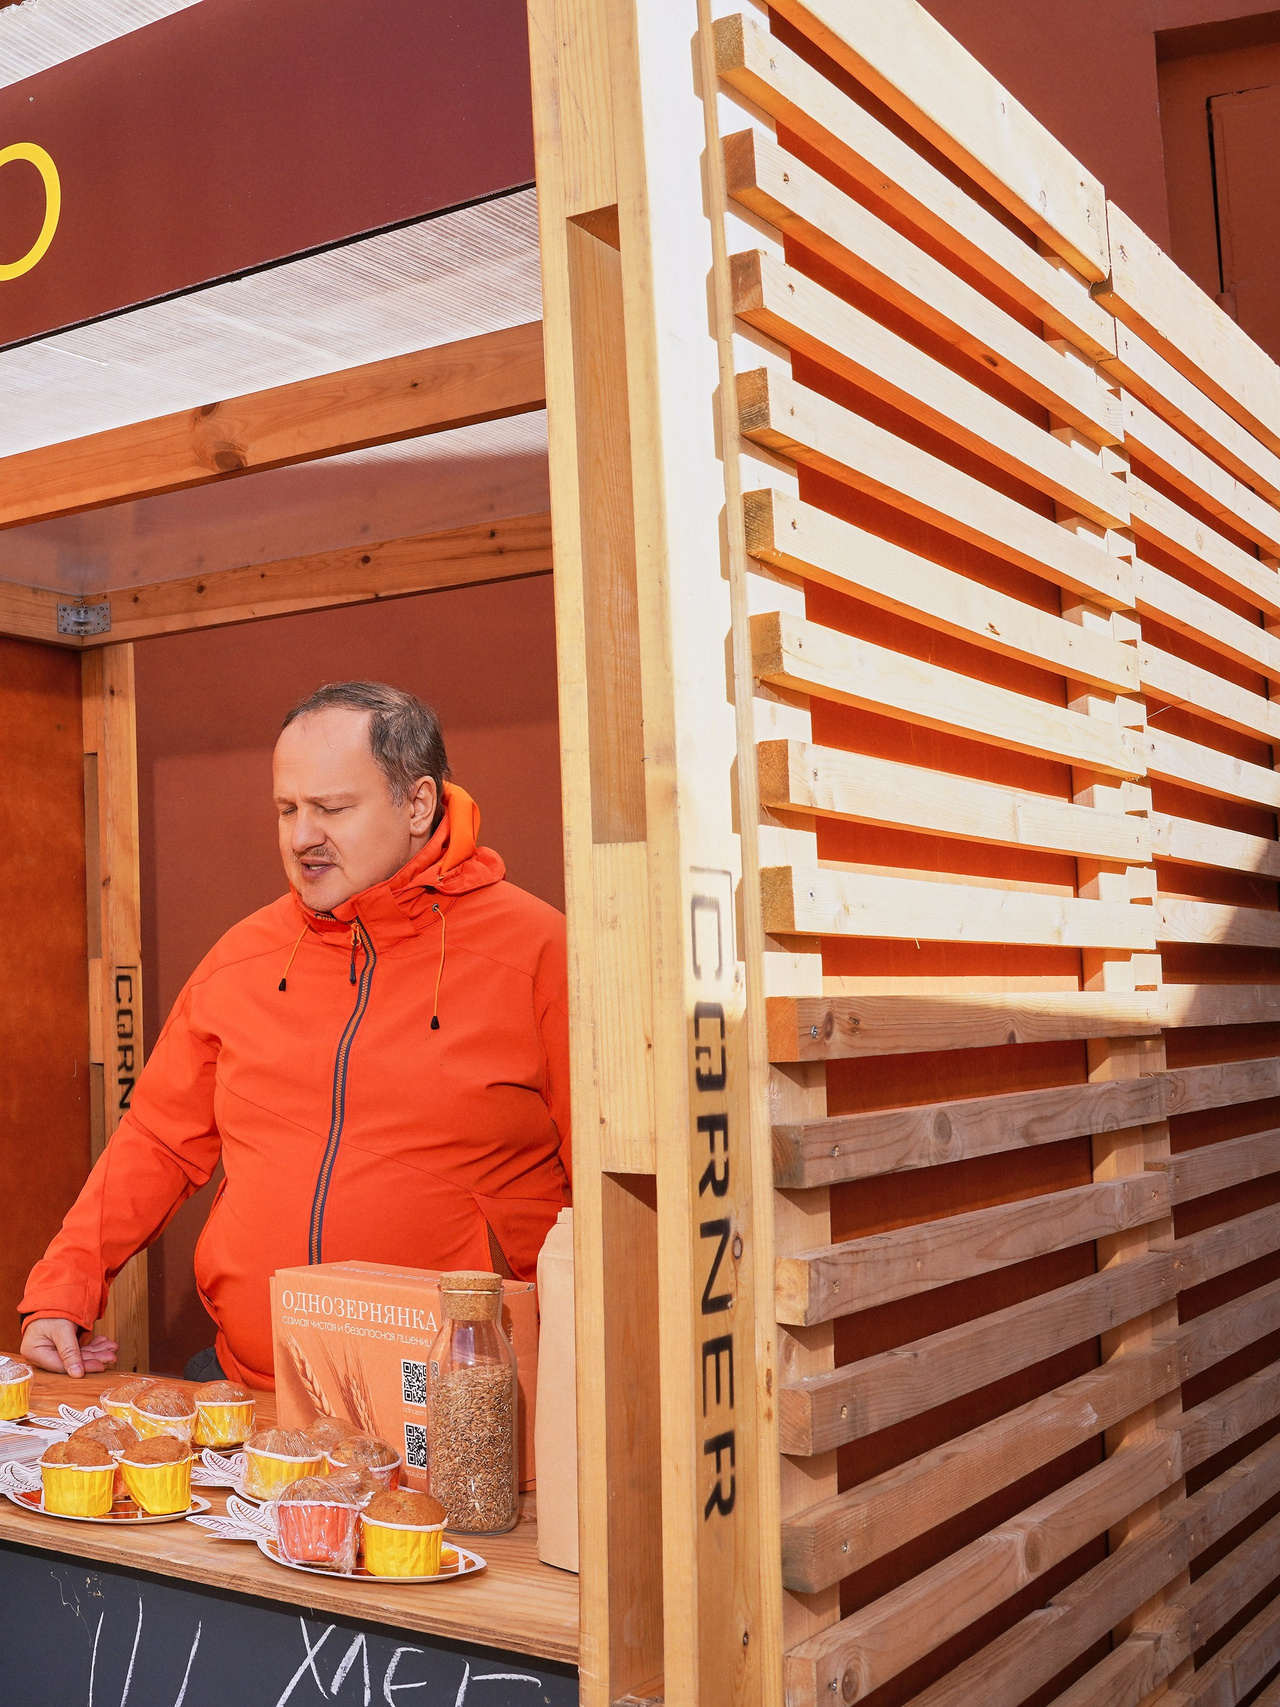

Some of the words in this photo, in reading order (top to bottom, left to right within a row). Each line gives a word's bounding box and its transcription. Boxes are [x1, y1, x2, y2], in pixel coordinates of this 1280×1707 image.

[116, 975, 135, 1122] CORN
[692, 895, 738, 1520] CORNER
[282, 1290, 438, 1332] ОДНОЗЕРНЯНКА
[282, 1315, 309, 1327] самая
[310, 1319, 337, 1332] чистая
[339, 1324, 344, 1332] и
[345, 1323, 396, 1341] безопасная
[397, 1334, 432, 1348] пшениц
